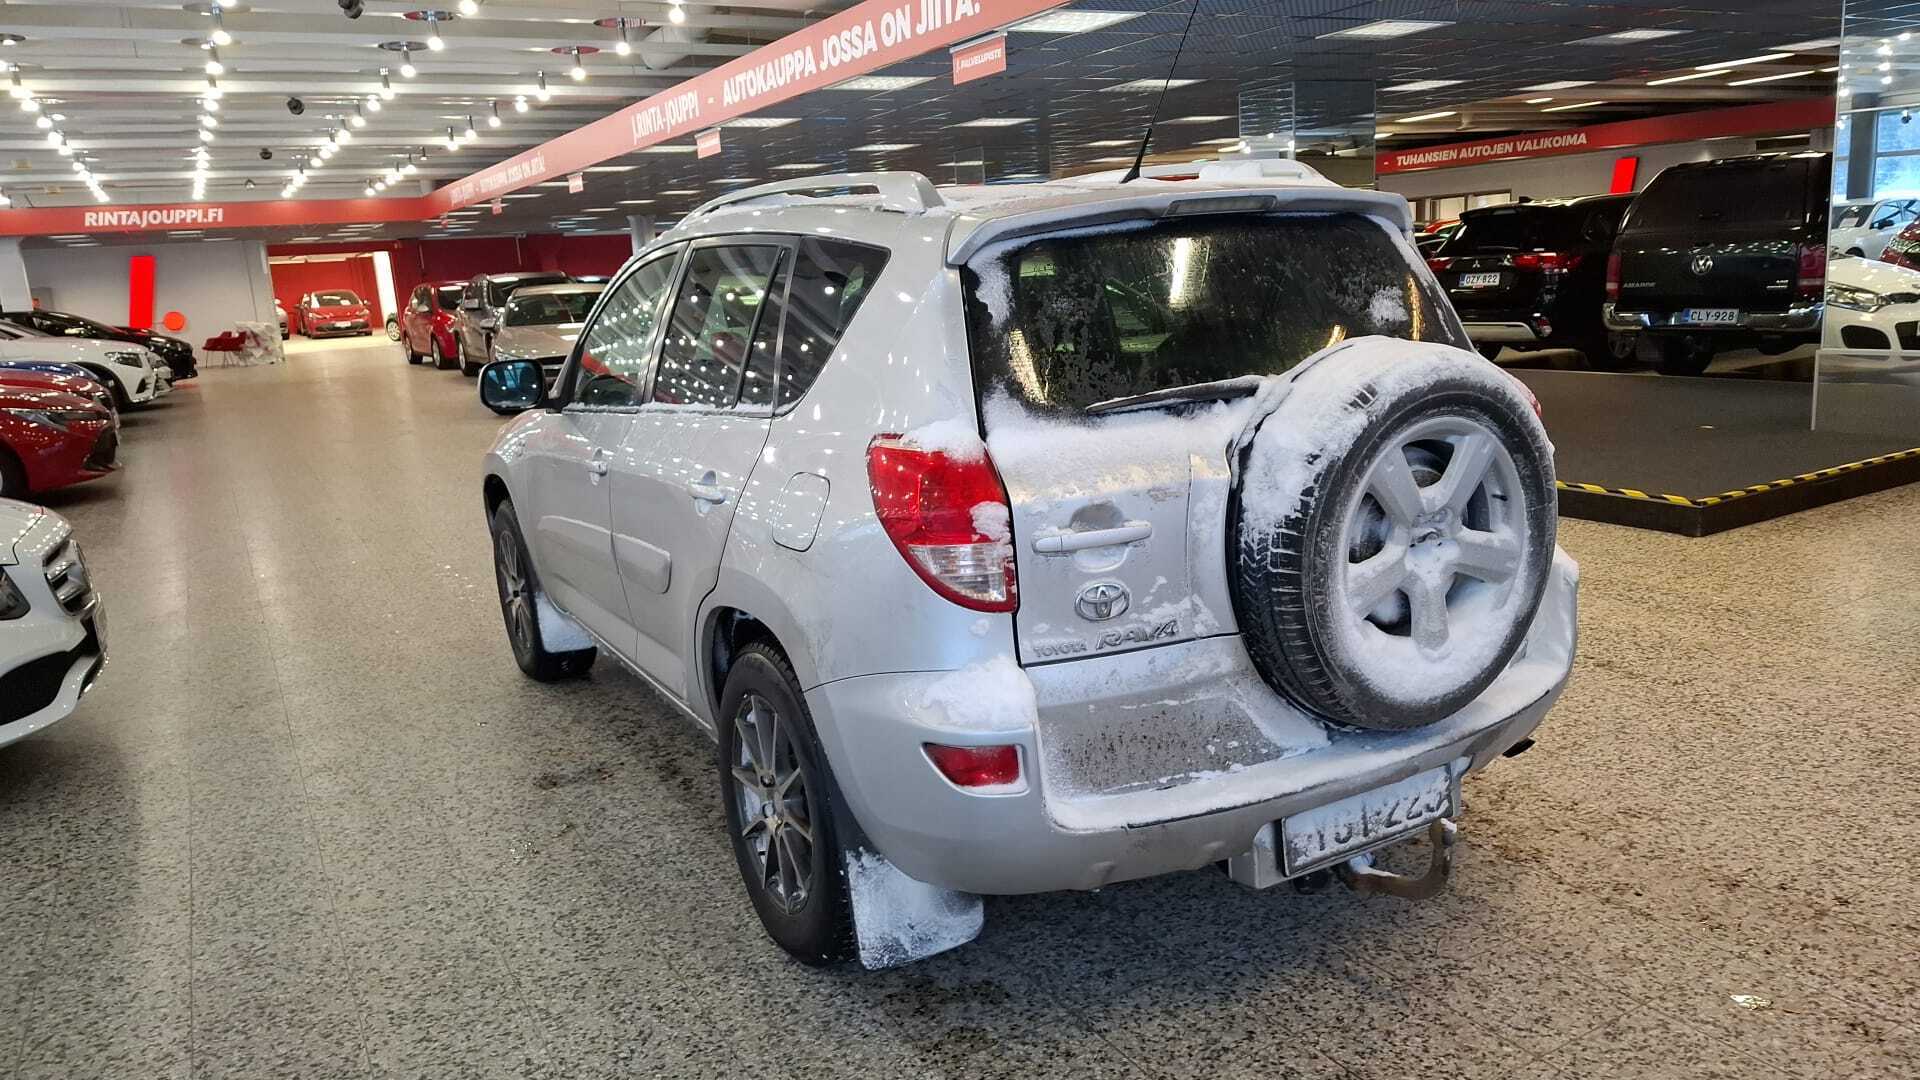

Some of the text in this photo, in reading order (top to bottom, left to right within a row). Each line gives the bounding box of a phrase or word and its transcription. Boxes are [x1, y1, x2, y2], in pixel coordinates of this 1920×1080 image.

[723, 46, 817, 107] AUTOKAUPPA
[819, 20, 879, 71] JOSSA
[880, 4, 911, 47] ON
[1396, 149, 1458, 167] TUHANSIEN
[1458, 142, 1514, 160] AUTOJEN
[1514, 133, 1588, 152] VALIKOIMA
[84, 207, 224, 229] RINTAJOUPPI.FI
[1690, 311, 1735, 321] CLY-928
[1033, 617, 1179, 658] TOYOTA RAV4
